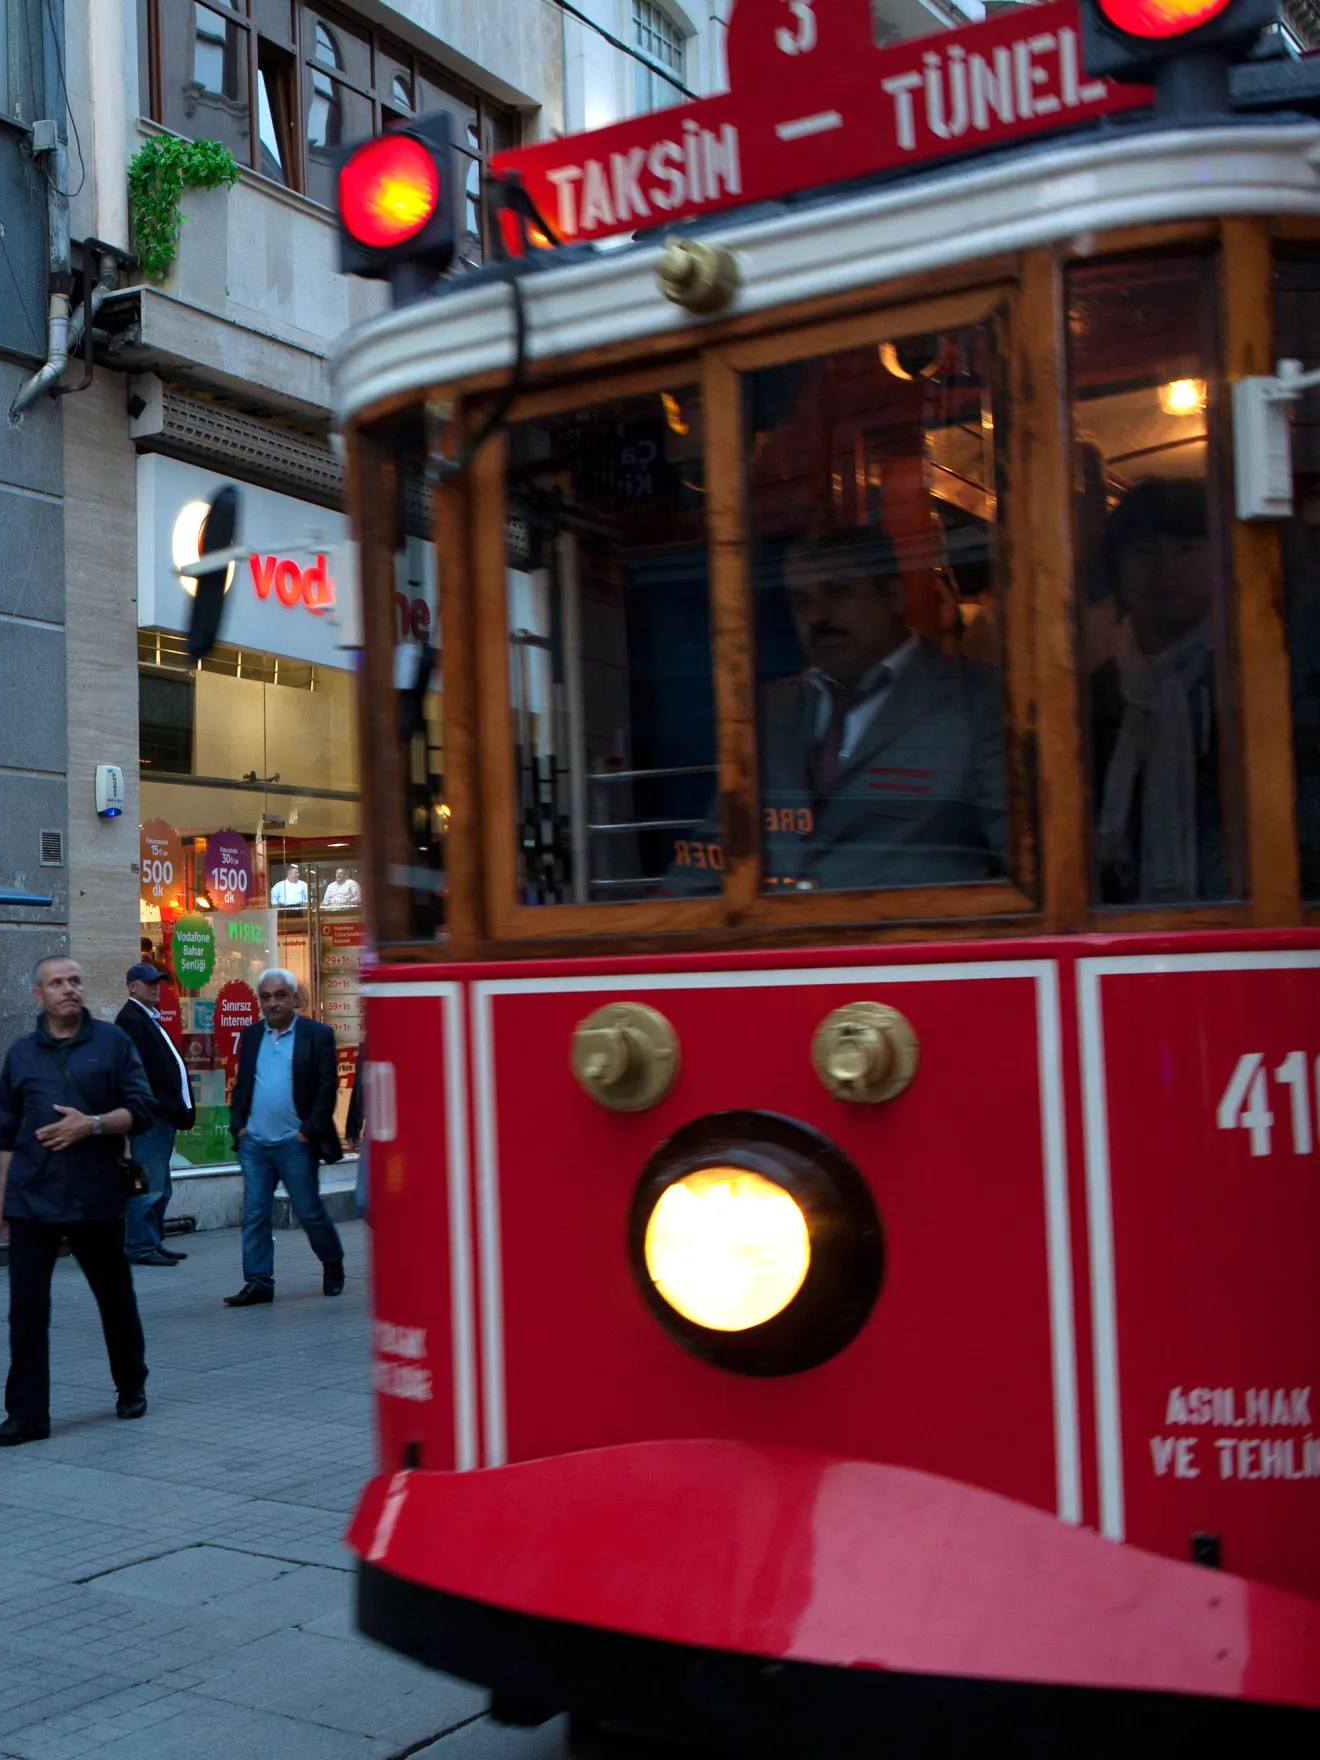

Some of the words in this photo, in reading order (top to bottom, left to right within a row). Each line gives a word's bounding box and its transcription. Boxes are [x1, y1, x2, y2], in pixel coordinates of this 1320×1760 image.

[880, 27, 1108, 151] TÜNEL
[142, 859, 173, 885] 500
[211, 867, 248, 892] 1500
[152, 883, 164, 897] dk
[224, 891, 235, 904] dk
[176, 931, 210, 943] Vodafone
[183, 945, 204, 956] Bahar
[181, 959, 206, 972] Şenliği
[222, 999, 252, 1012] Sınırsız
[220, 1014, 253, 1027] internet
[1216, 1050, 1320, 1157] 41
[1149, 1435, 1201, 1479] VE
[1213, 1432, 1320, 1480] TEHLİ
